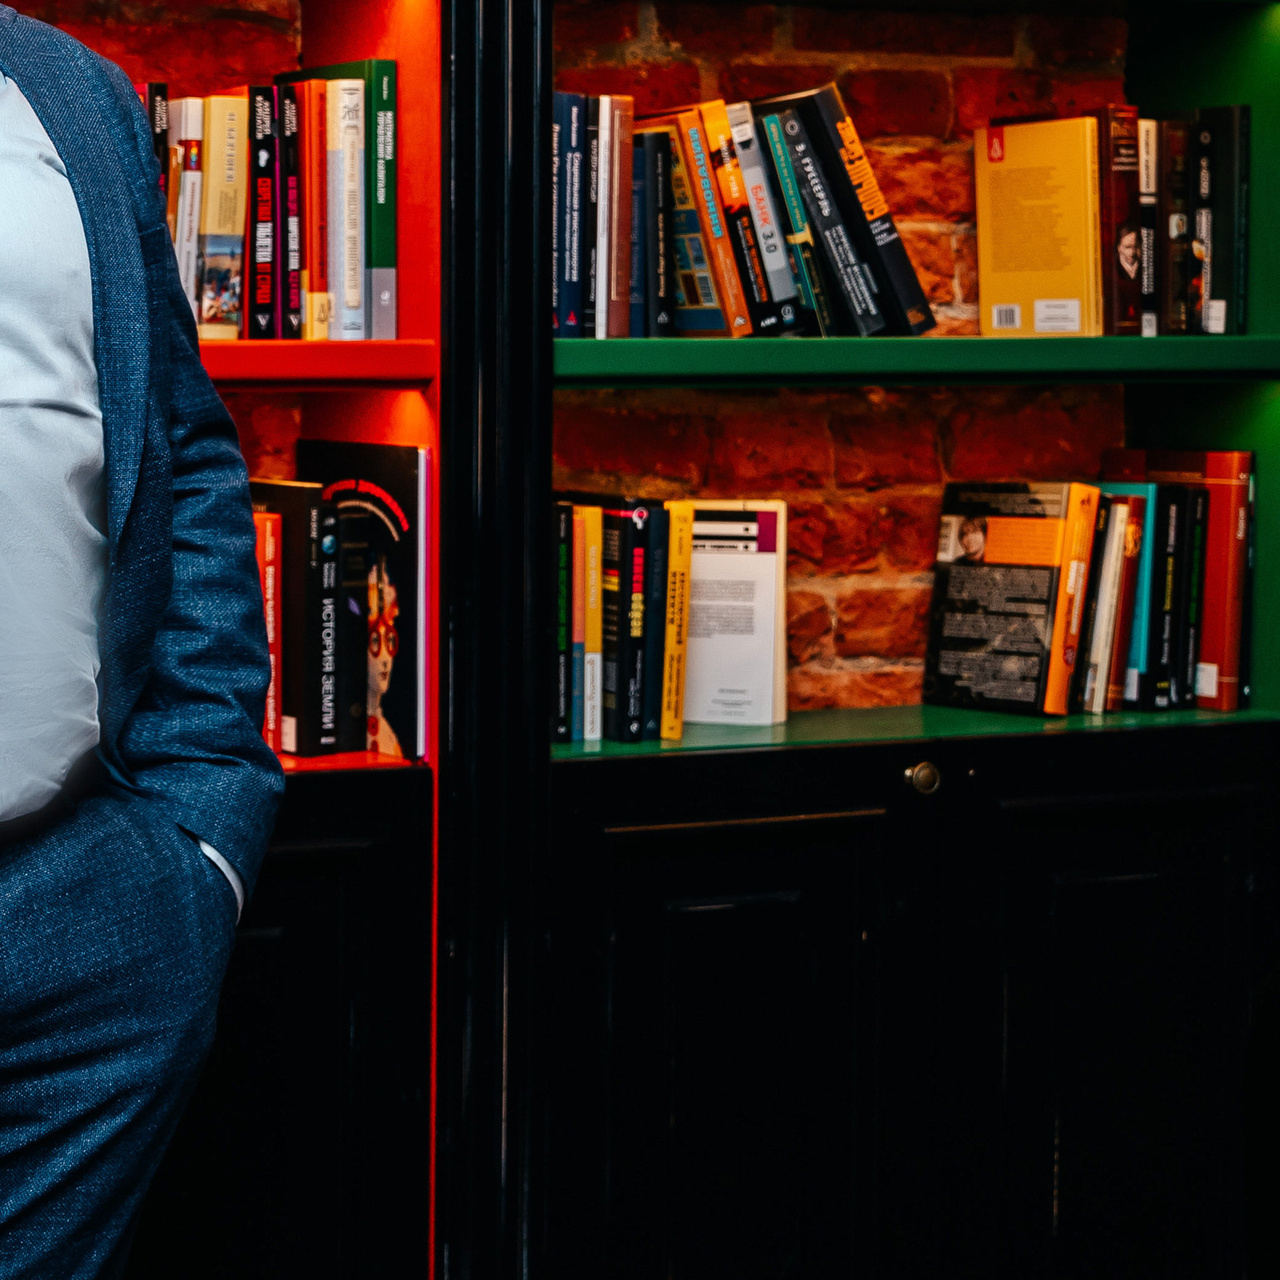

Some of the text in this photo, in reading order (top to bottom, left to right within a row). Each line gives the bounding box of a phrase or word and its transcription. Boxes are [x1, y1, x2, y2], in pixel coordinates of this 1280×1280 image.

[376, 111, 384, 158] УПРАВЛЕНИЯ
[384, 110, 392, 160] МАТЕМАТИКА
[256, 177, 271, 221] СЕКРЕТНАЯ
[749, 184, 771, 227] БАНК
[761, 230, 776, 253] 3.0
[255, 222, 272, 263] ТАБЛЕТКА
[320, 598, 334, 730] ИСТОРИЯ ЗЕМЛИ
